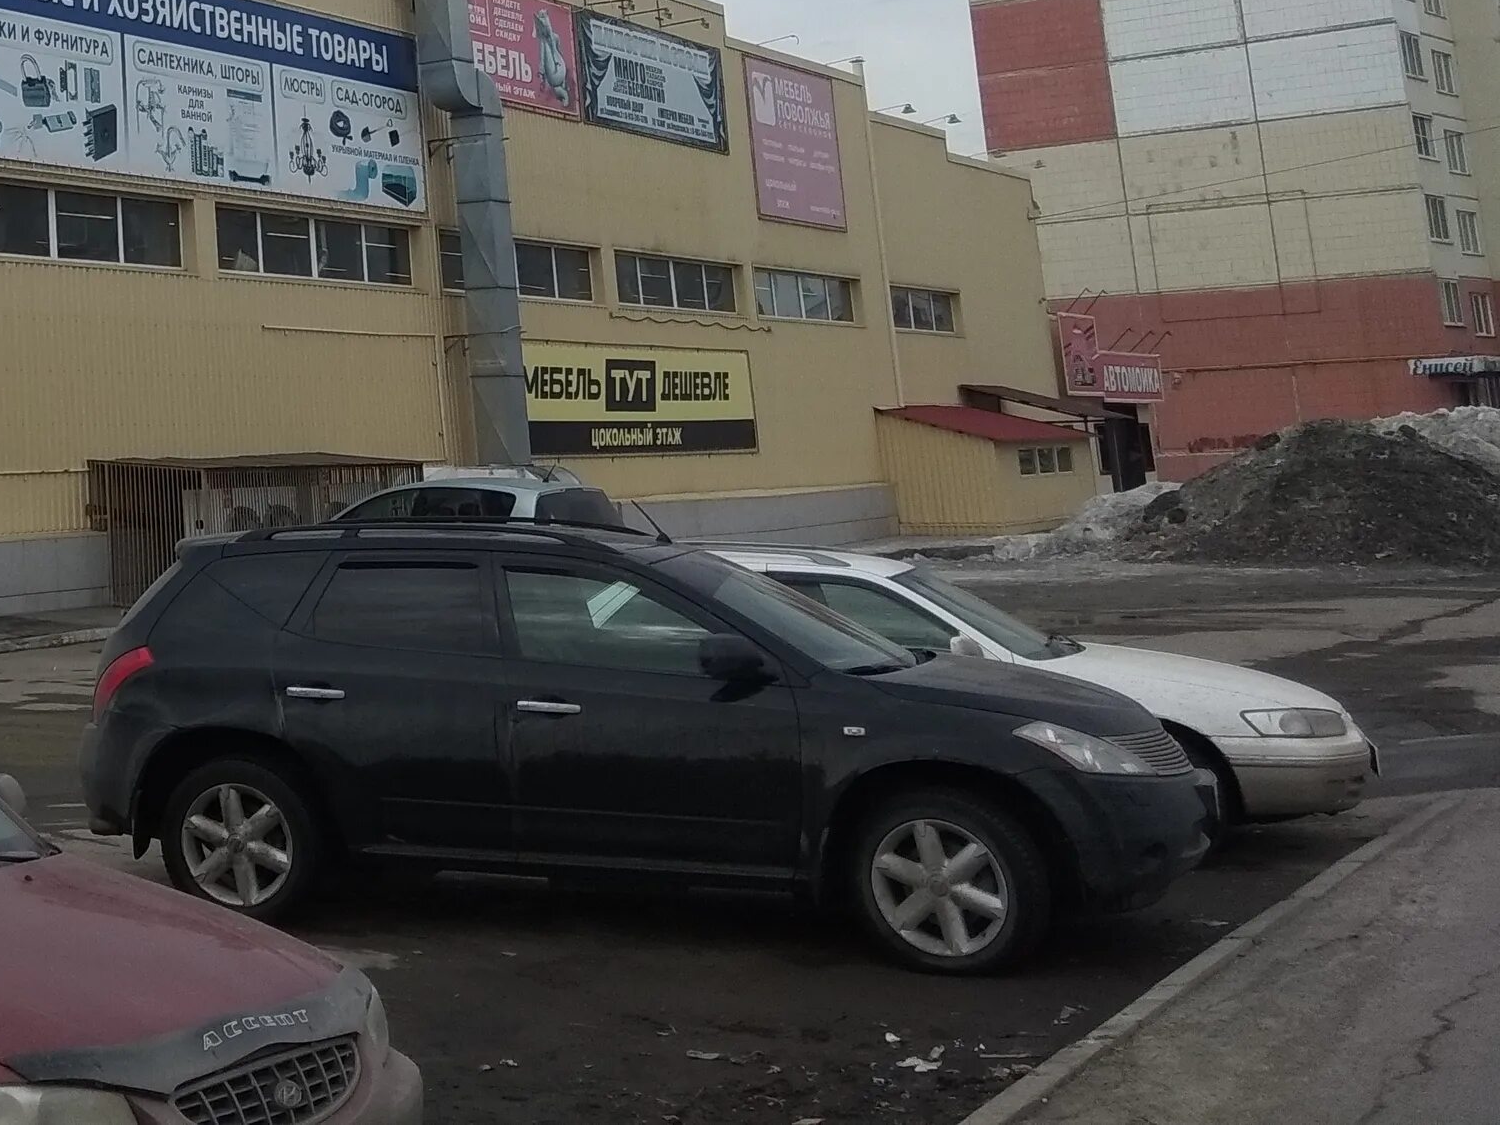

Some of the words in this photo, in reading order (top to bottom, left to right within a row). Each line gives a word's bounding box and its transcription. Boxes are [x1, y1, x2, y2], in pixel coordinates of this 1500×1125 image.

[494, 17, 524, 32] СДЕЛАЕМ
[495, 29, 521, 43] СКИДКУ
[19, 24, 30, 43] И
[33, 26, 110, 58] ФУРНИТУРА
[307, 28, 389, 74] ТОВАРЫ
[137, 47, 217, 79] САНТЕХНИКА,
[220, 63, 261, 86] ШТОРЫ
[472, 40, 533, 83] ЕБЕЛЬ
[613, 56, 646, 84] МНОГО
[177, 83, 214, 100] КАРНИЗЫ
[283, 79, 323, 97] ЛЮСТРЫ
[335, 86, 403, 115] САД-ОГОРОД
[513, 86, 536, 99] ЭТАЖ
[774, 77, 812, 104] МЕБЕЛЬ
[180, 109, 213, 123] ВАННОЙ
[188, 98, 205, 110] ДЛЯ
[777, 100, 830, 130] ПОВОЛЖЬЯ
[331, 144, 362, 158] УКРЫВНОЙ
[363, 149, 393, 162] МАТЕРИАЛ
[398, 155, 420, 167] ПЛЕНКА
[1412, 358, 1474, 378] Енисей
[523, 365, 601, 400] МЕБЕЛЬ
[611, 369, 651, 402] ТУТ
[660, 371, 730, 401] ДЕШЕВЛЕ
[591, 423, 652, 449] ЦОКОЛЬНЫЙ
[656, 427, 683, 446] ЭТАЖ
